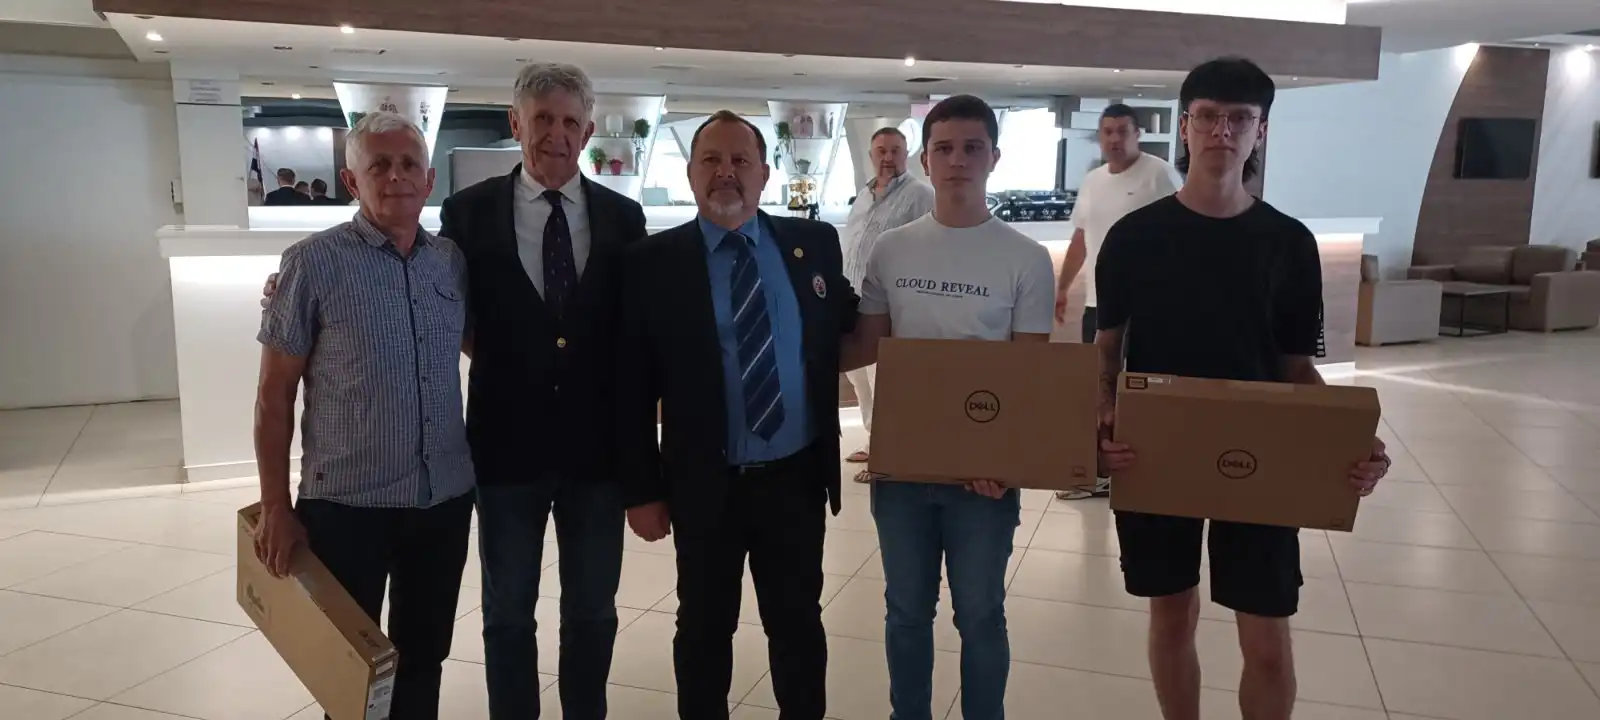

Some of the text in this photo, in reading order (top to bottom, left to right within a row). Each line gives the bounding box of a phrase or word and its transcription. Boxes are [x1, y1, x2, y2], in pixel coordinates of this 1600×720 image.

[895, 278, 937, 290] CLOUD
[941, 281, 990, 297] REVEAL
[969, 402, 996, 412] DELL
[1222, 459, 1253, 470] DELL
